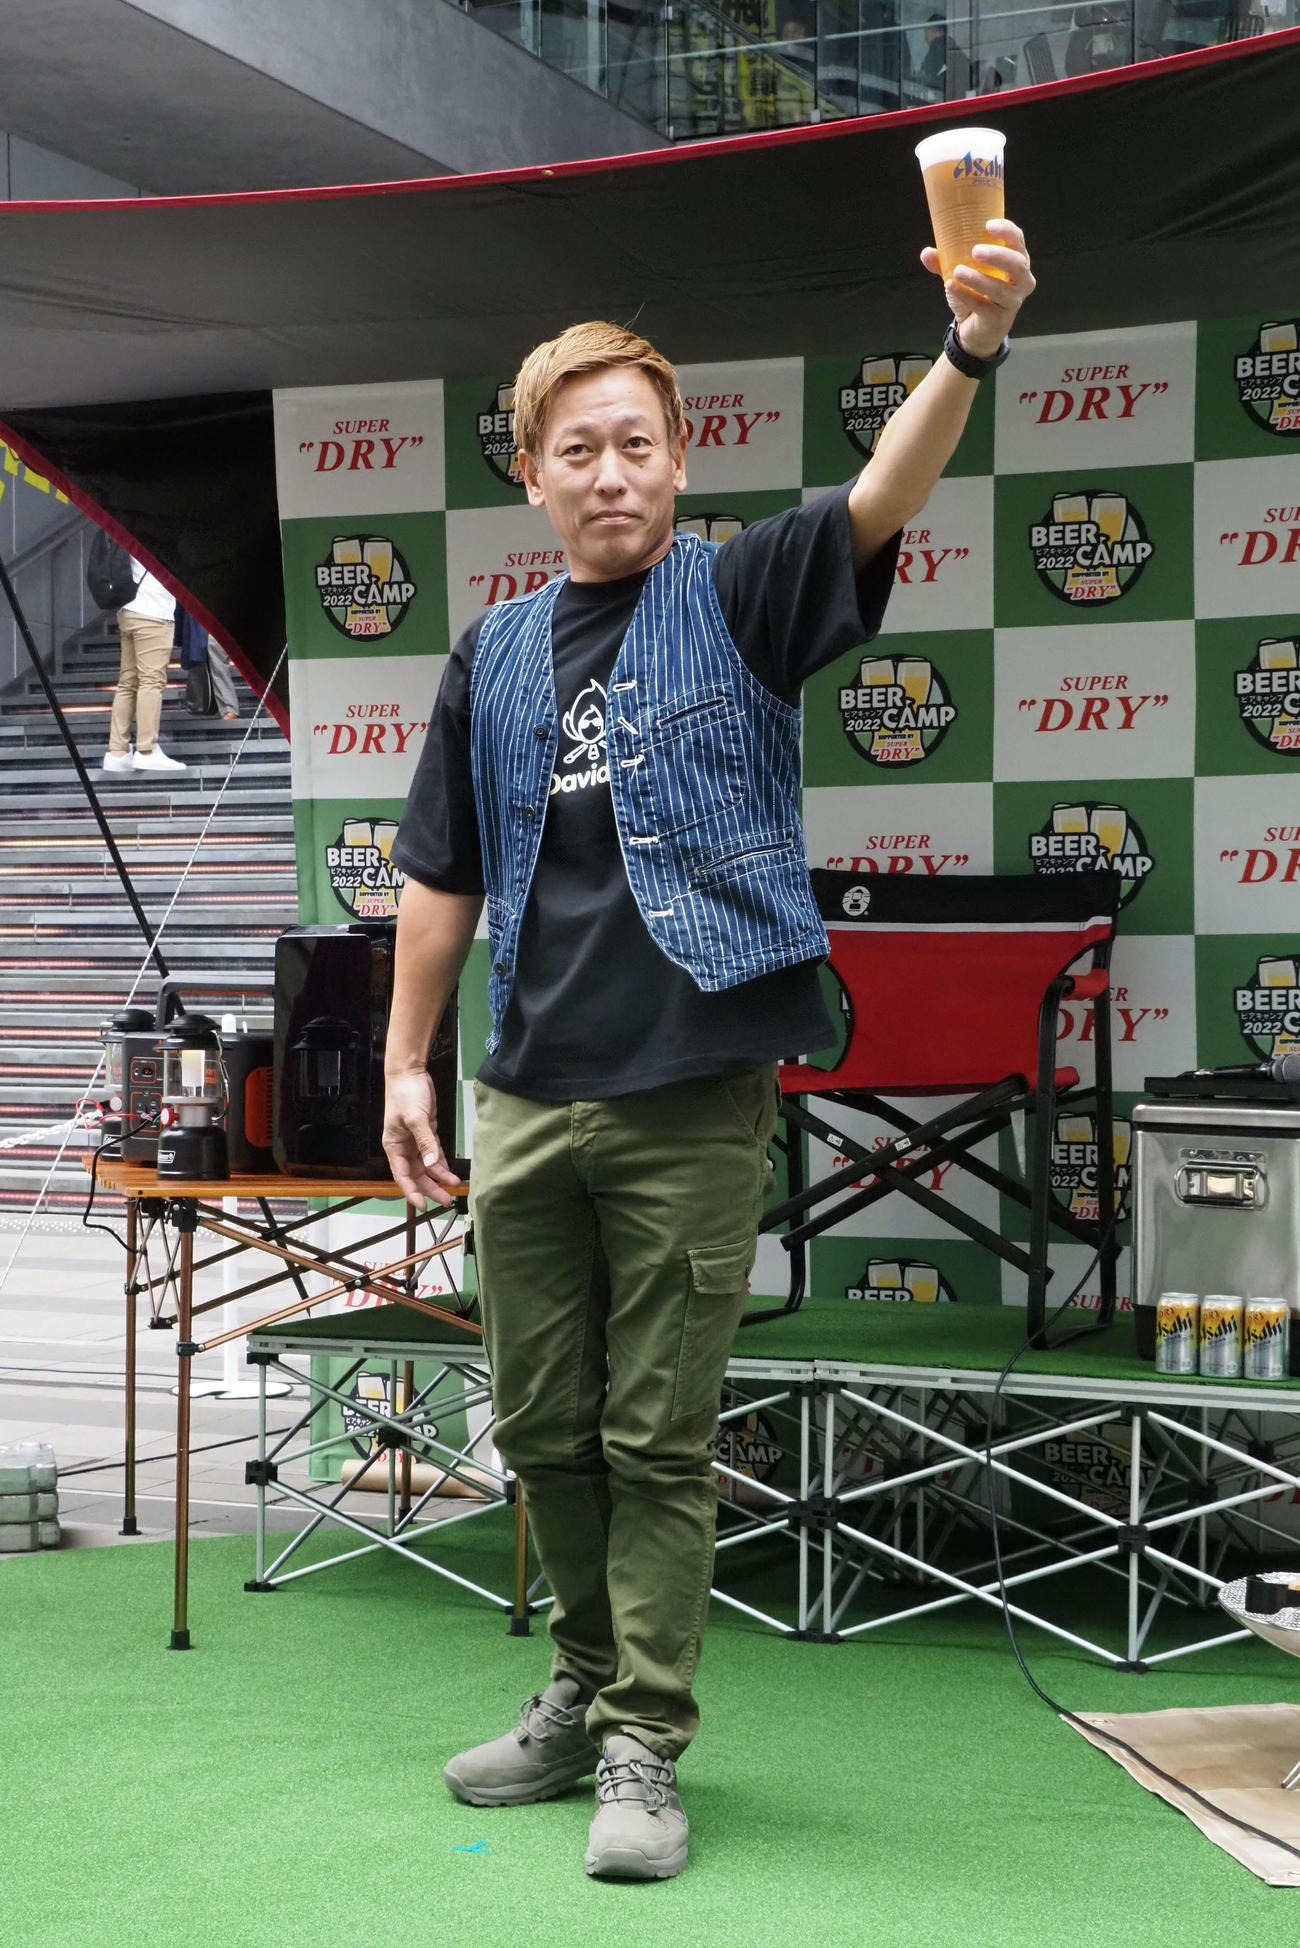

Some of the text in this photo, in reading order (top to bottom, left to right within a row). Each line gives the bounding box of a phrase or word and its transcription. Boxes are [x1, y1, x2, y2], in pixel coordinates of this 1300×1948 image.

[954, 151, 1003, 179] Asah
[1061, 364, 1129, 383] SUPER
[1237, 352, 1300, 378] BEER
[683, 394, 744, 411] SUPER
[841, 385, 904, 409] BEER
[1019, 382, 1169, 424] “DRY”
[1242, 386, 1281, 400] 2022
[333, 419, 389, 434] SUPER
[685, 411, 780, 448] RY”
[845, 417, 881, 431] 2022
[299, 435, 423, 472] “DRY”
[484, 442, 516, 455] 2022
[1032, 524, 1097, 547] BEER
[505, 551, 564, 567] SUPER
[1037, 556, 1074, 569] 2022
[1076, 542, 1152, 566] CAMP
[317, 565, 370, 586] BEER
[893, 548, 969, 584] RY”
[323, 595, 352, 606] 2022
[353, 583, 415, 604] CAMP
[1060, 675, 1128, 691] SUPER
[1237, 670, 1300, 694] BEER
[841, 687, 903, 709] BEER
[346, 704, 400, 718] SUPER
[883, 706, 955, 729] CAMP
[1018, 694, 1169, 732] “DRY”
[1242, 704, 1281, 717] 2022
[845, 719, 881, 731] 2022
[866, 834, 931, 850] SUPER
[1032, 835, 1097, 856] BEER
[327, 848, 380, 867] BEER
[1076, 856, 1153, 877] CAMP
[332, 876, 361, 887] 2022
[362, 867, 408, 887] CAM
[1236, 989, 1300, 1011] BEER
[1242, 1021, 1281, 1034] 2022
[1054, 1144, 1099, 1165] EER
[1051, 1175, 1079, 1187] 022
[1044, 1442, 1109, 1465] BEER
